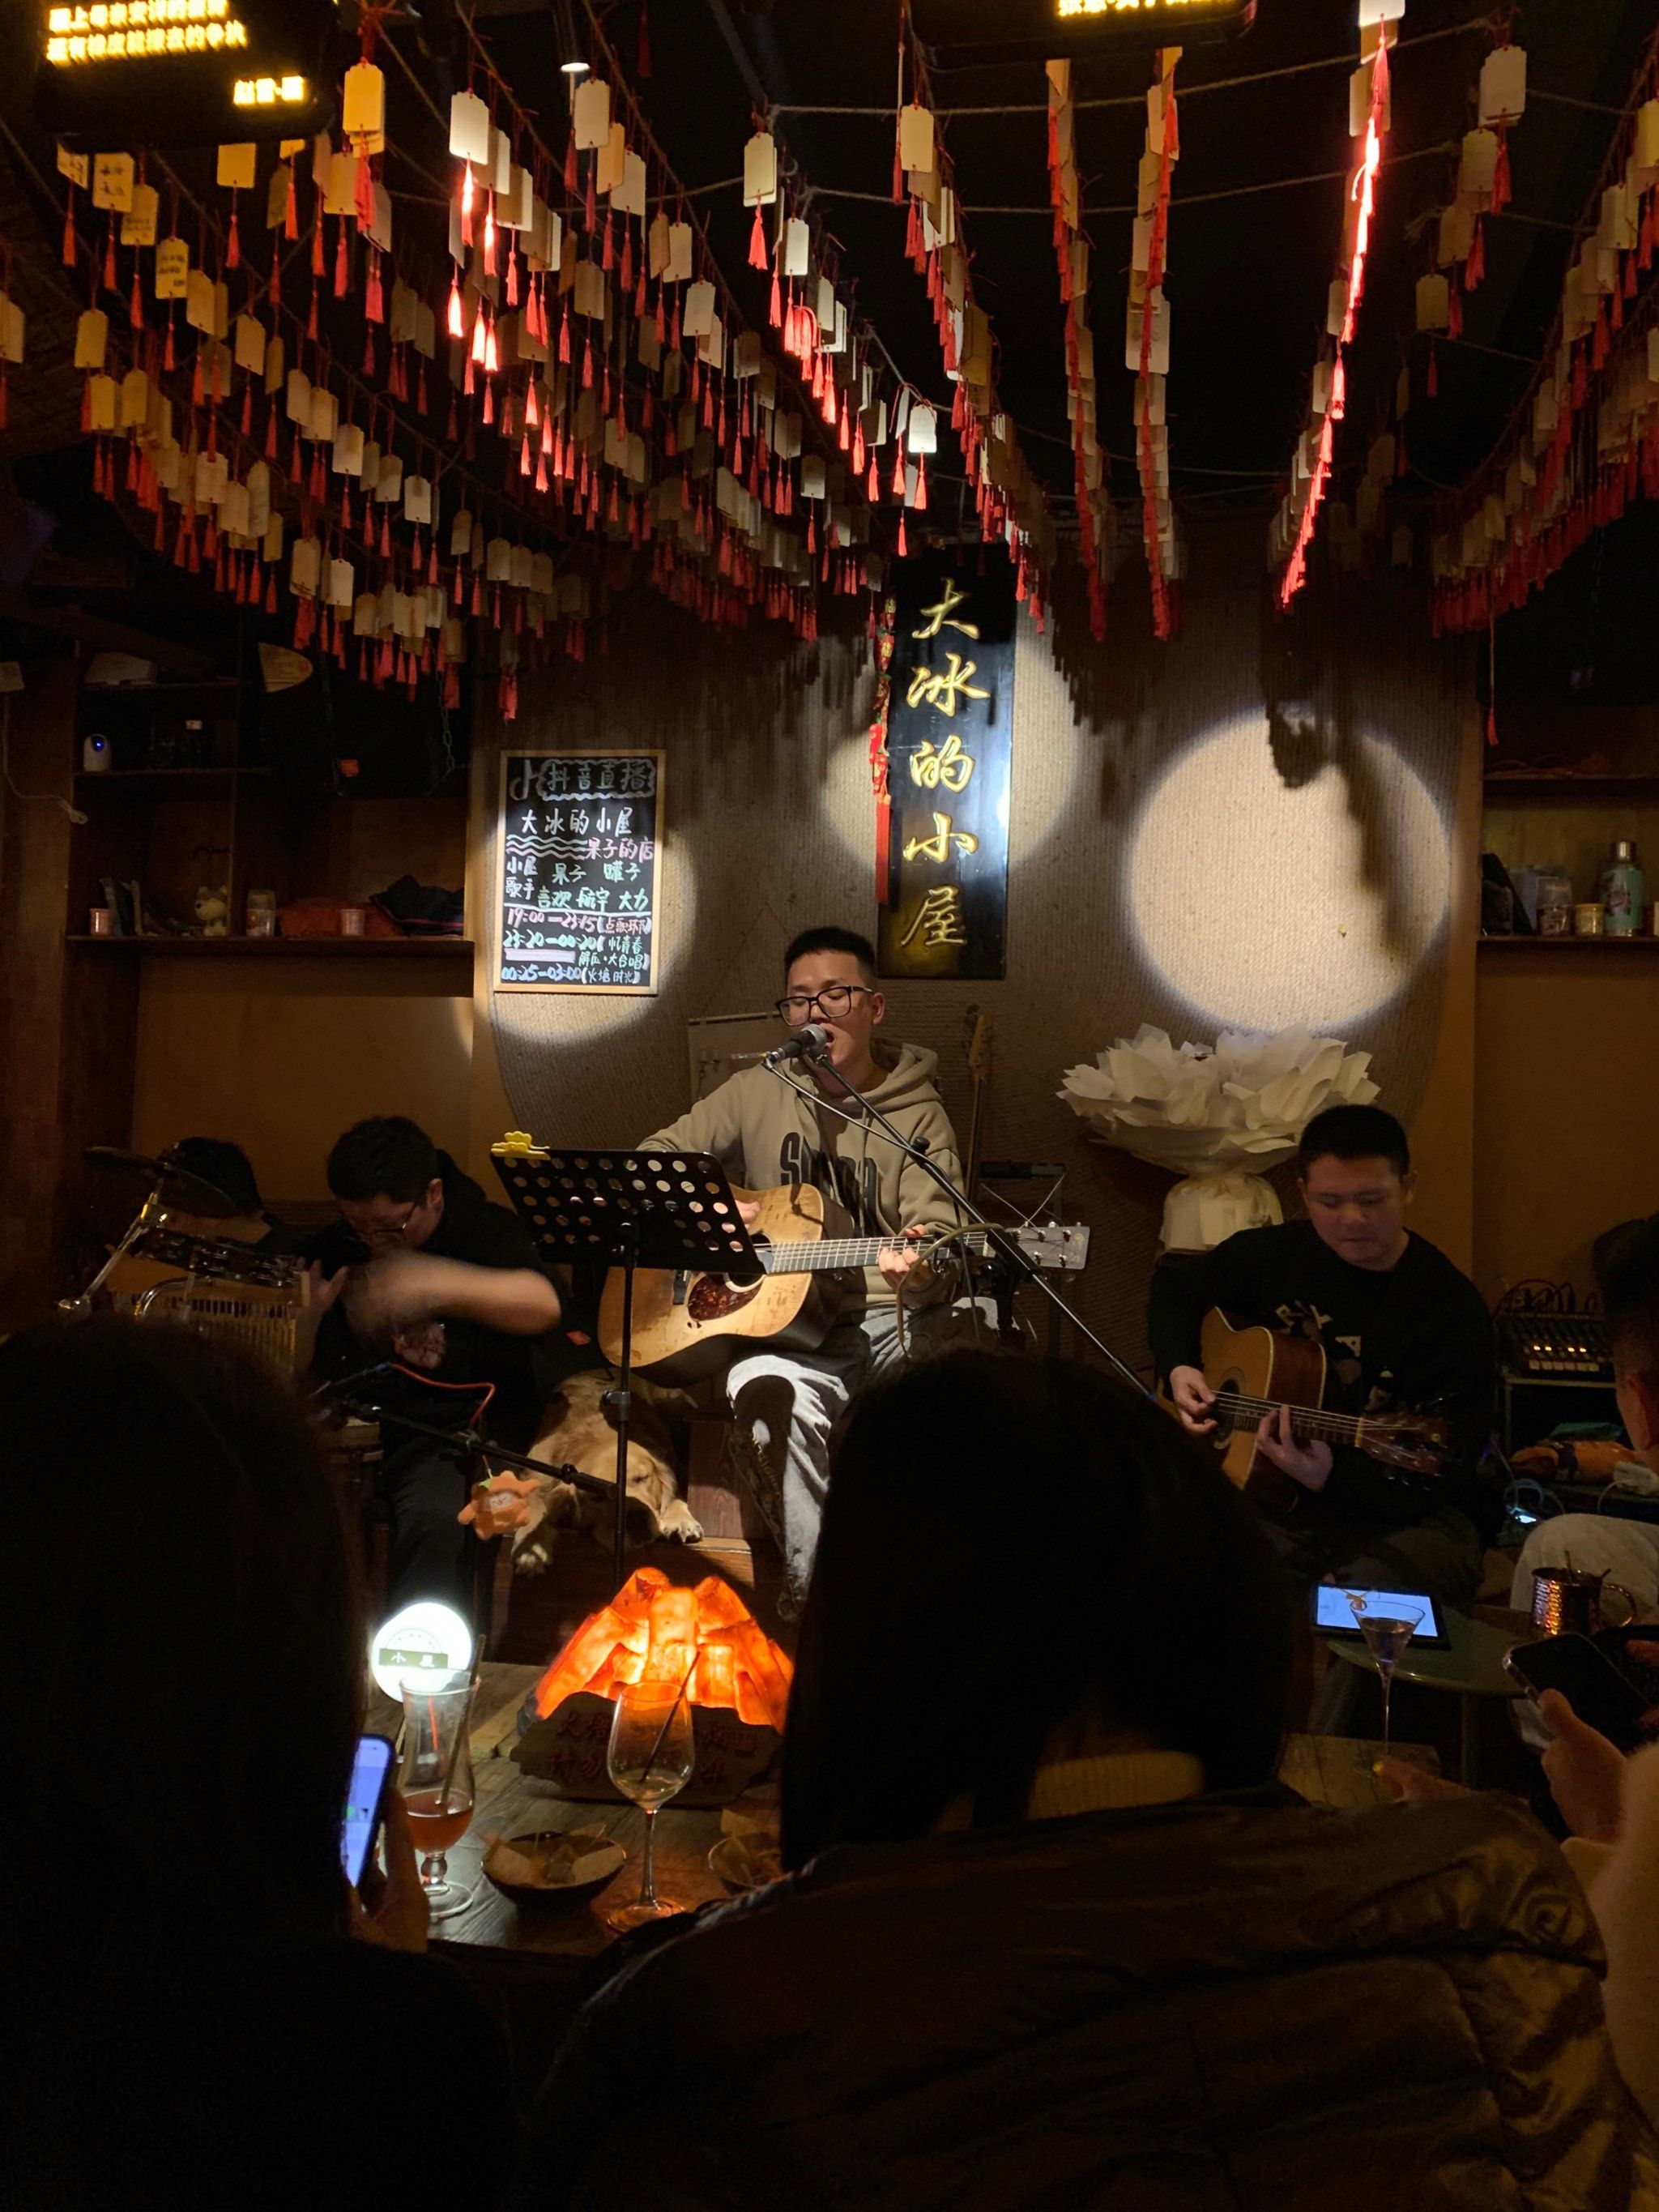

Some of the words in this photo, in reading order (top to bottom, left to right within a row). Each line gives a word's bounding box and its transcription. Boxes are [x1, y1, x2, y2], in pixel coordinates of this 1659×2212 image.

[900, 576, 991, 949] 大冰的小屋
[547, 762, 647, 792] 抖音直播
[521, 806, 633, 837] 大冰的小屋
[586, 835, 655, 864] 果子的店
[506, 856, 538, 877] 小屋
[552, 862, 587, 886] 果子
[505, 877, 535, 901] 歌手
[618, 887, 649, 912] 大力
